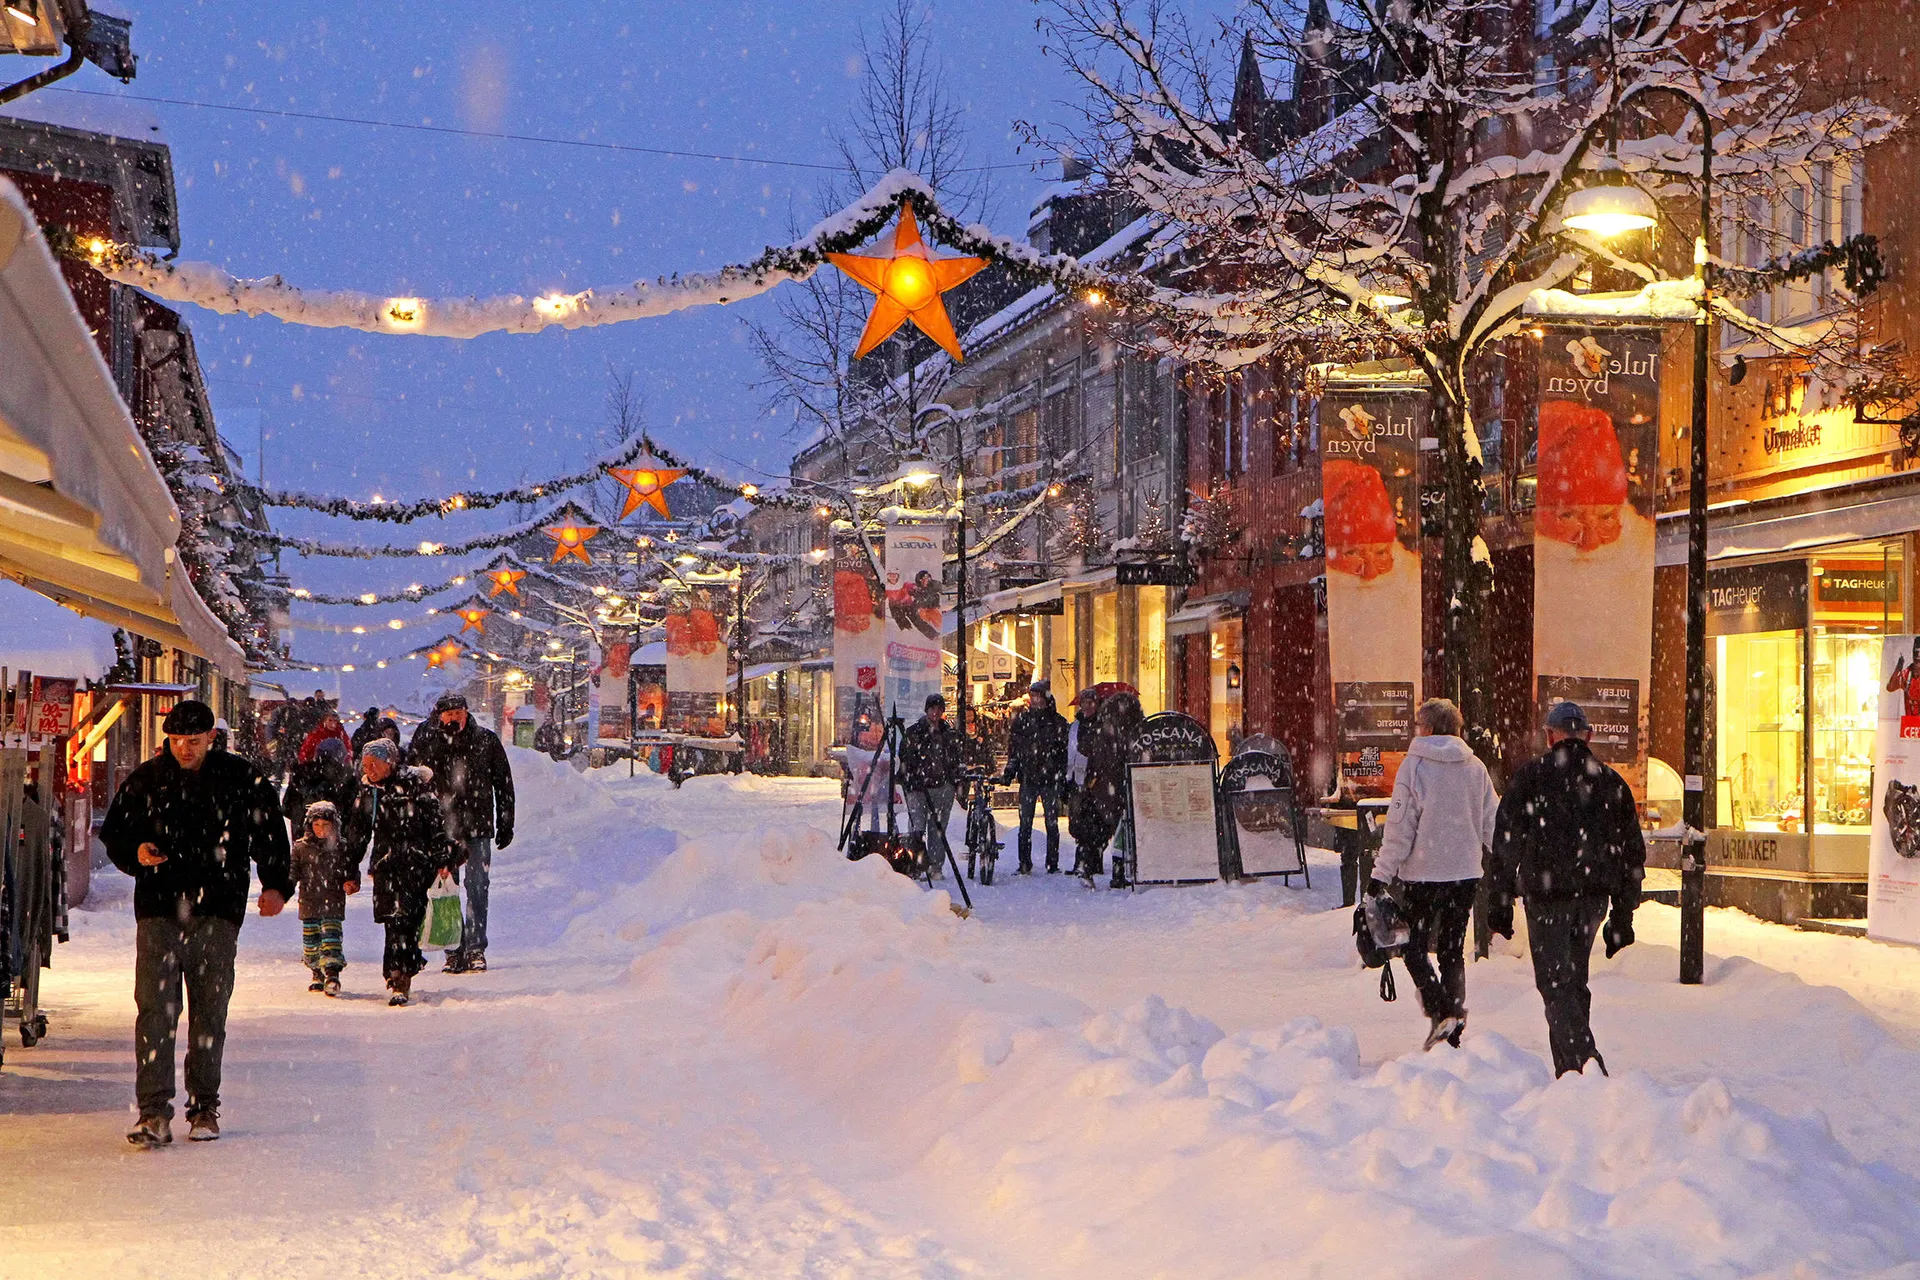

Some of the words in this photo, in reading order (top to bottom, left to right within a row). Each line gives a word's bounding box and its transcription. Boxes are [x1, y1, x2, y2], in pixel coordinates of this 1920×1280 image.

[1132, 726, 1203, 752] TOSCANA
[1904, 726, 1920, 739] CER
[1721, 838, 1778, 861] URMAKER
